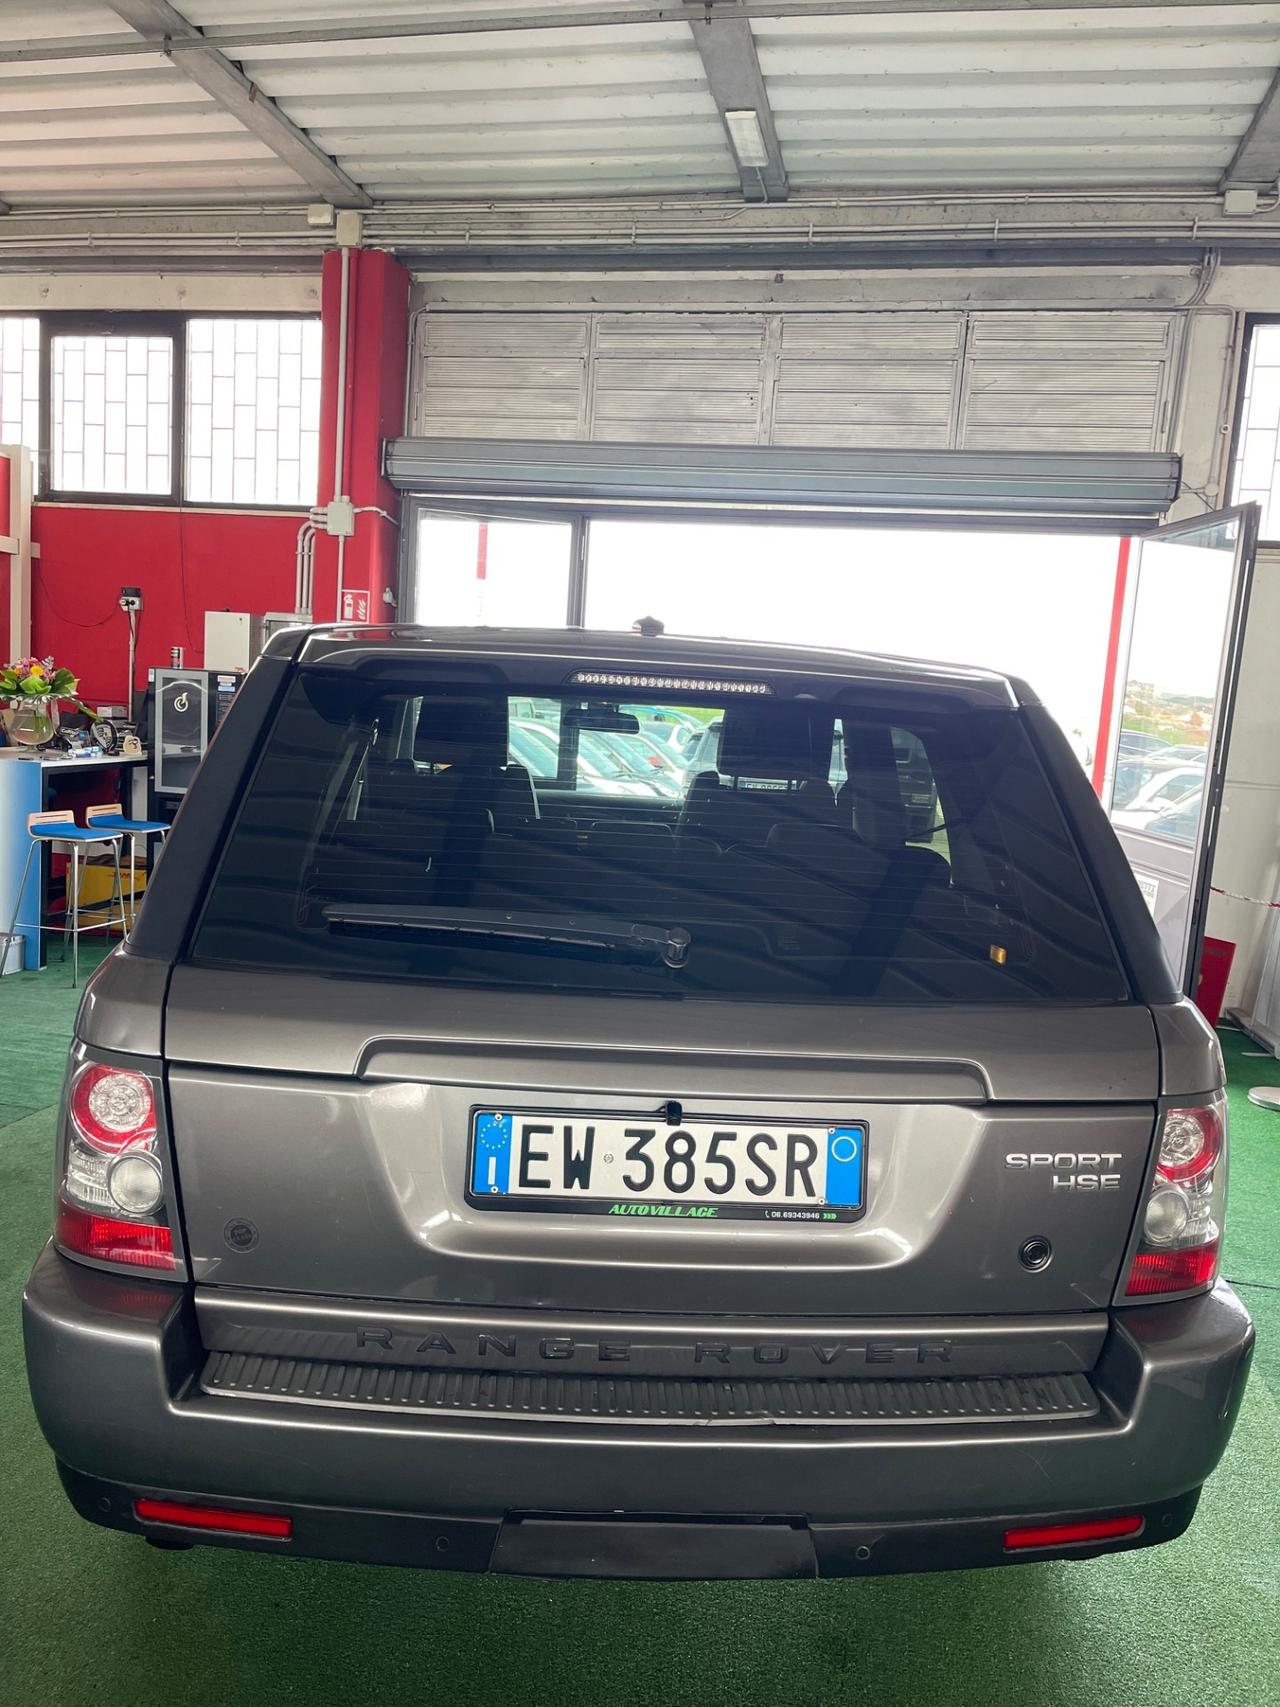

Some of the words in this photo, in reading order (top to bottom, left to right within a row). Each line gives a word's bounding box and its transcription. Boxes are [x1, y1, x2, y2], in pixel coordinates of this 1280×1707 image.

[518, 1125, 596, 1190] EW
[622, 1128, 819, 1197] 385SR
[1005, 1153, 1122, 1169] SPORT
[1053, 1174, 1121, 1190] HSE
[608, 1204, 719, 1218] AUTOVILLAGE
[356, 1326, 631, 1361] RANGE
[694, 1341, 951, 1365] ROVER
